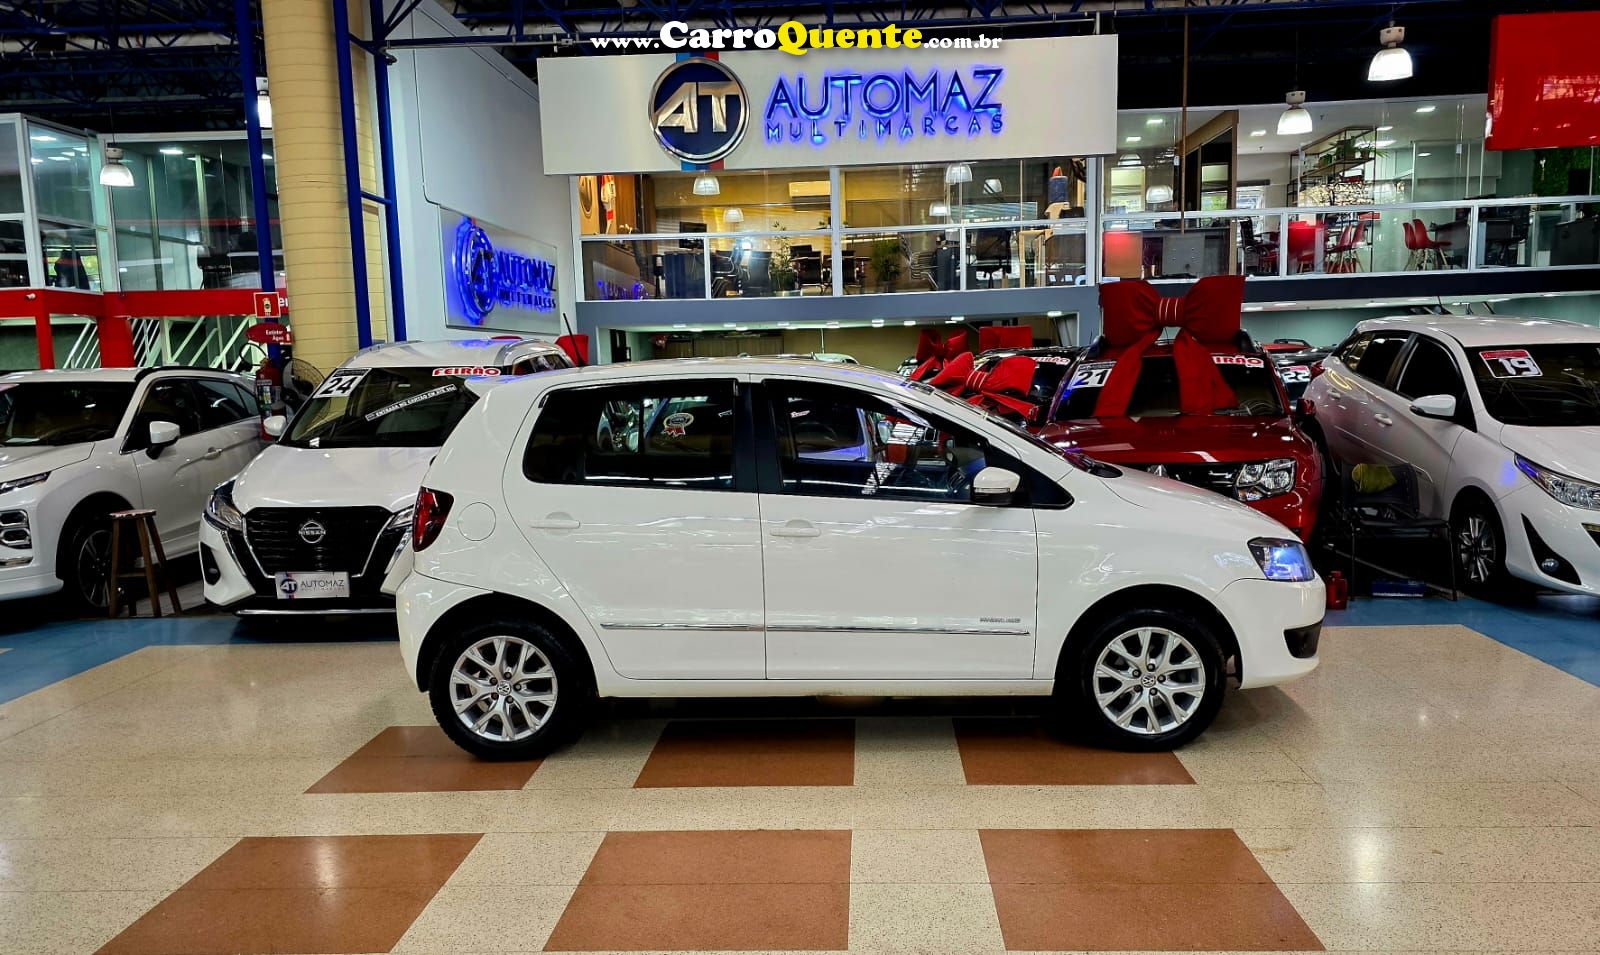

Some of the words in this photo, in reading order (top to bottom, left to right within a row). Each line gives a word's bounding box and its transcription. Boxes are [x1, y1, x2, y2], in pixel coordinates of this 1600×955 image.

[766, 68, 1003, 120] AUTOMAZ
[766, 113, 1004, 142] MULTIMARCAS
[1498, 358, 1539, 375] 19
[319, 376, 358, 395] 24
[1073, 369, 1109, 387] 21
